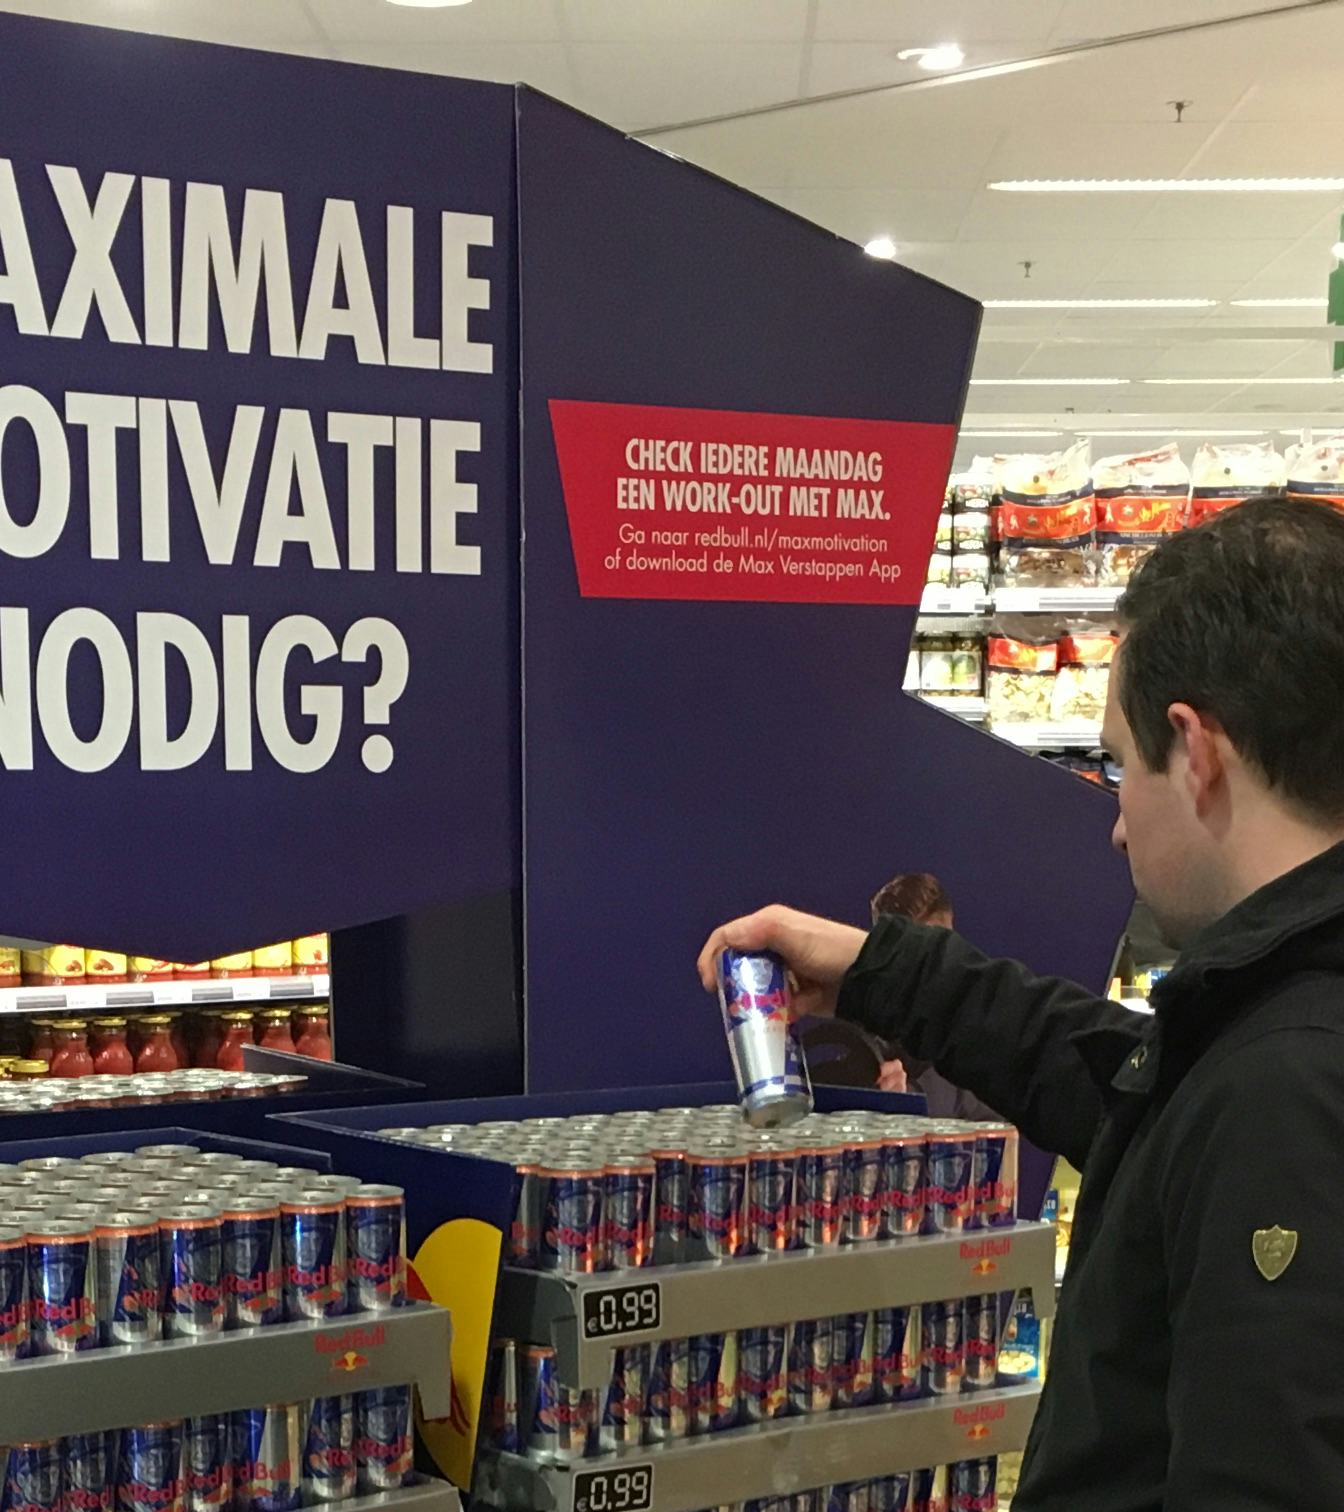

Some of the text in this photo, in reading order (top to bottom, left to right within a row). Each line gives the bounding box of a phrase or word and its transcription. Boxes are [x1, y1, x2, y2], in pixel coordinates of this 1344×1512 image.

[625, 438, 883, 482] CHECK IEDERE MAANDAG
[617, 478, 891, 521] EEN WORK-OUT MET MAX.
[618, 524, 888, 553] Ga naar redbull.nl/maxmotivation
[604, 549, 901, 582] of download de Max Verstappen App
[34, 1300, 77, 1321] Red
